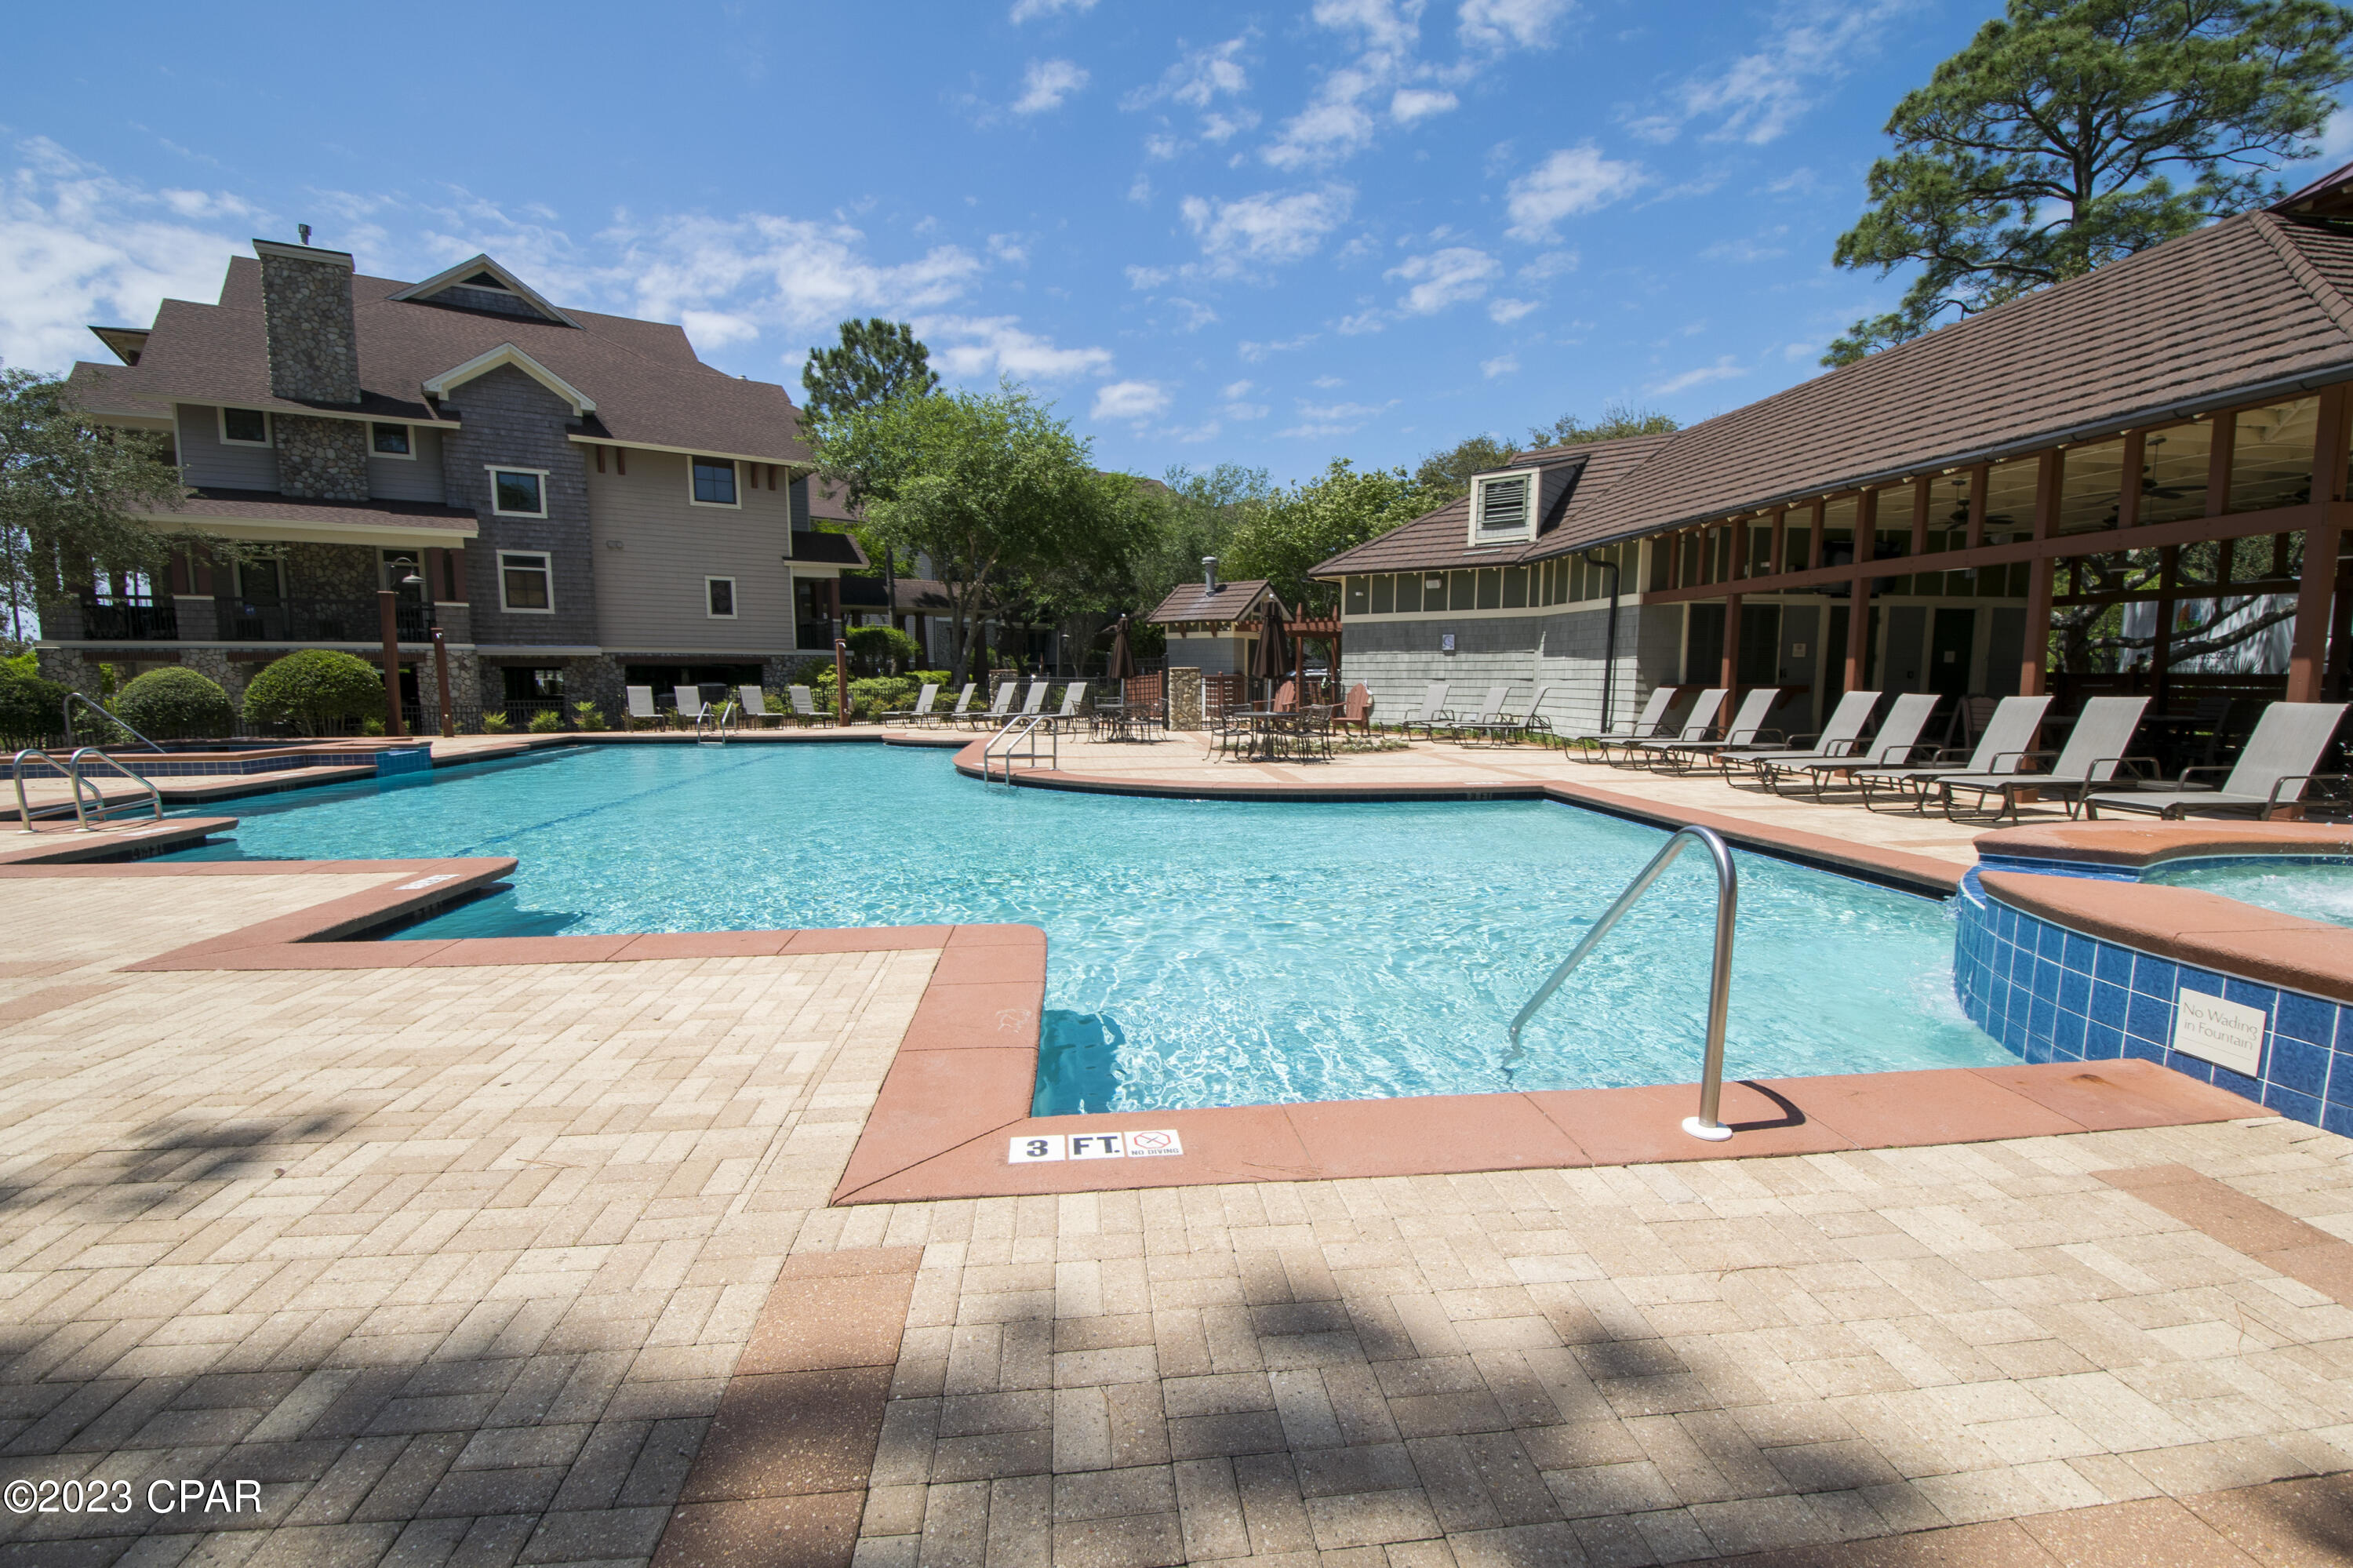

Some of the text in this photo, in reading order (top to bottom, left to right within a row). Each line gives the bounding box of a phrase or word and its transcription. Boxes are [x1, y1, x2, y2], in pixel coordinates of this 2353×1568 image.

[2183, 1002, 2258, 1041] No Wading
[2184, 1019, 2253, 1050] in Fountain
[1026, 1135, 1121, 1158] 3 FT.
